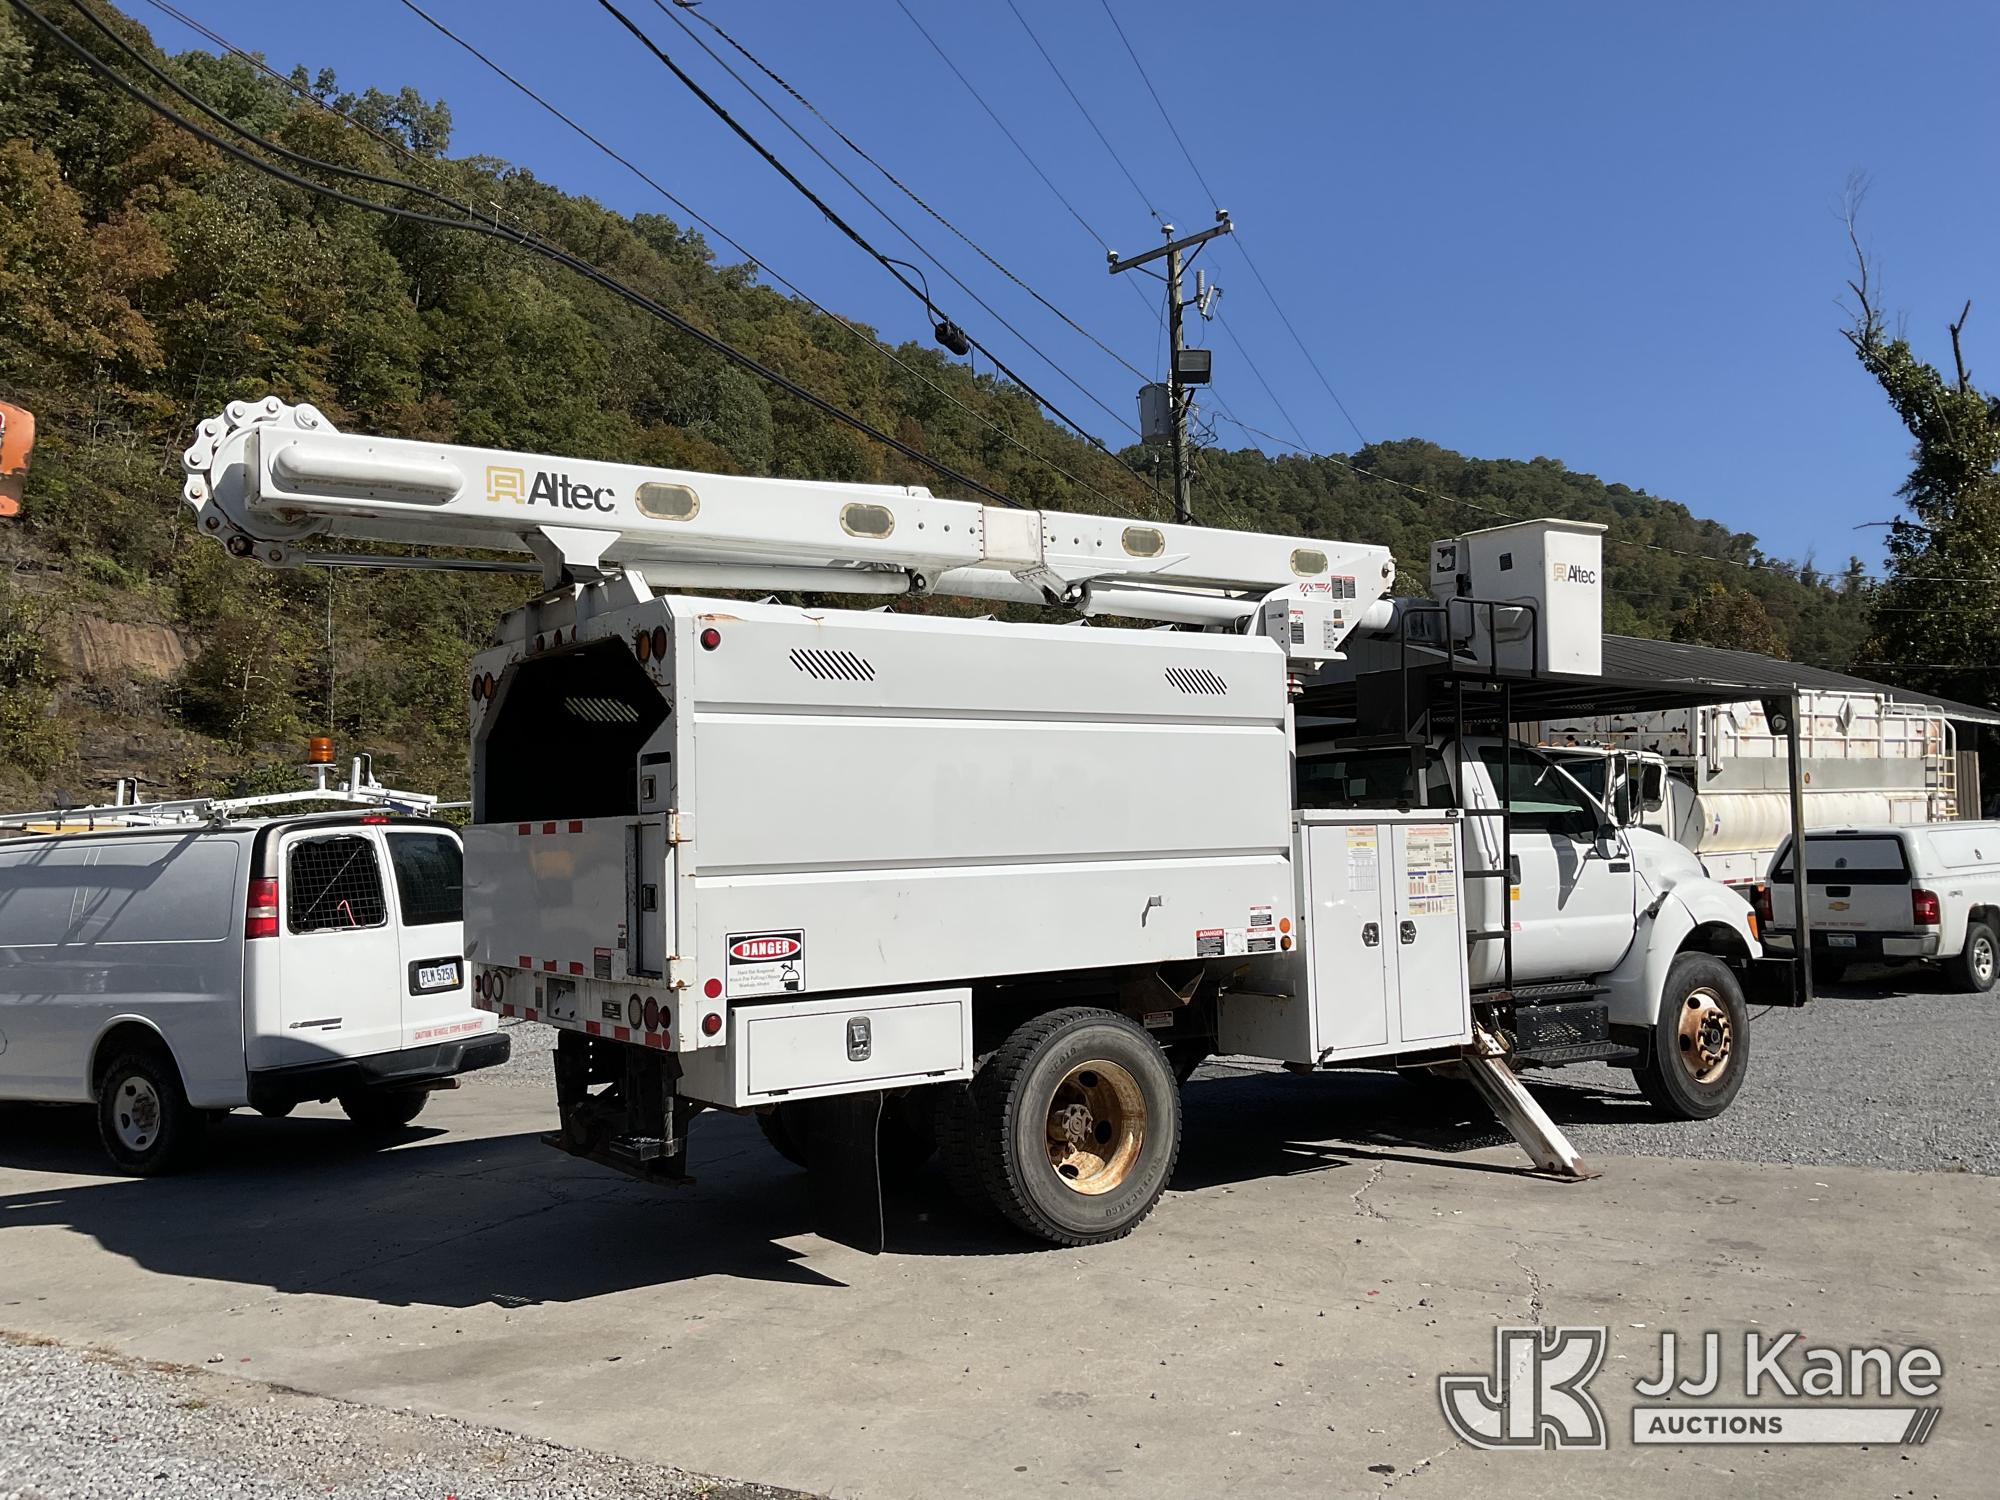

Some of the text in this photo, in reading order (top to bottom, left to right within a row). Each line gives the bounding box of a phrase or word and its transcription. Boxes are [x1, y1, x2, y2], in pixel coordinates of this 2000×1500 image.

[527, 471, 616, 513] Altec
[1567, 564, 1596, 584] Altec
[742, 940, 790, 956] DANGER
[436, 967, 455, 981] 5258
[1105, 1155, 1162, 1217] SUPERCARGO
